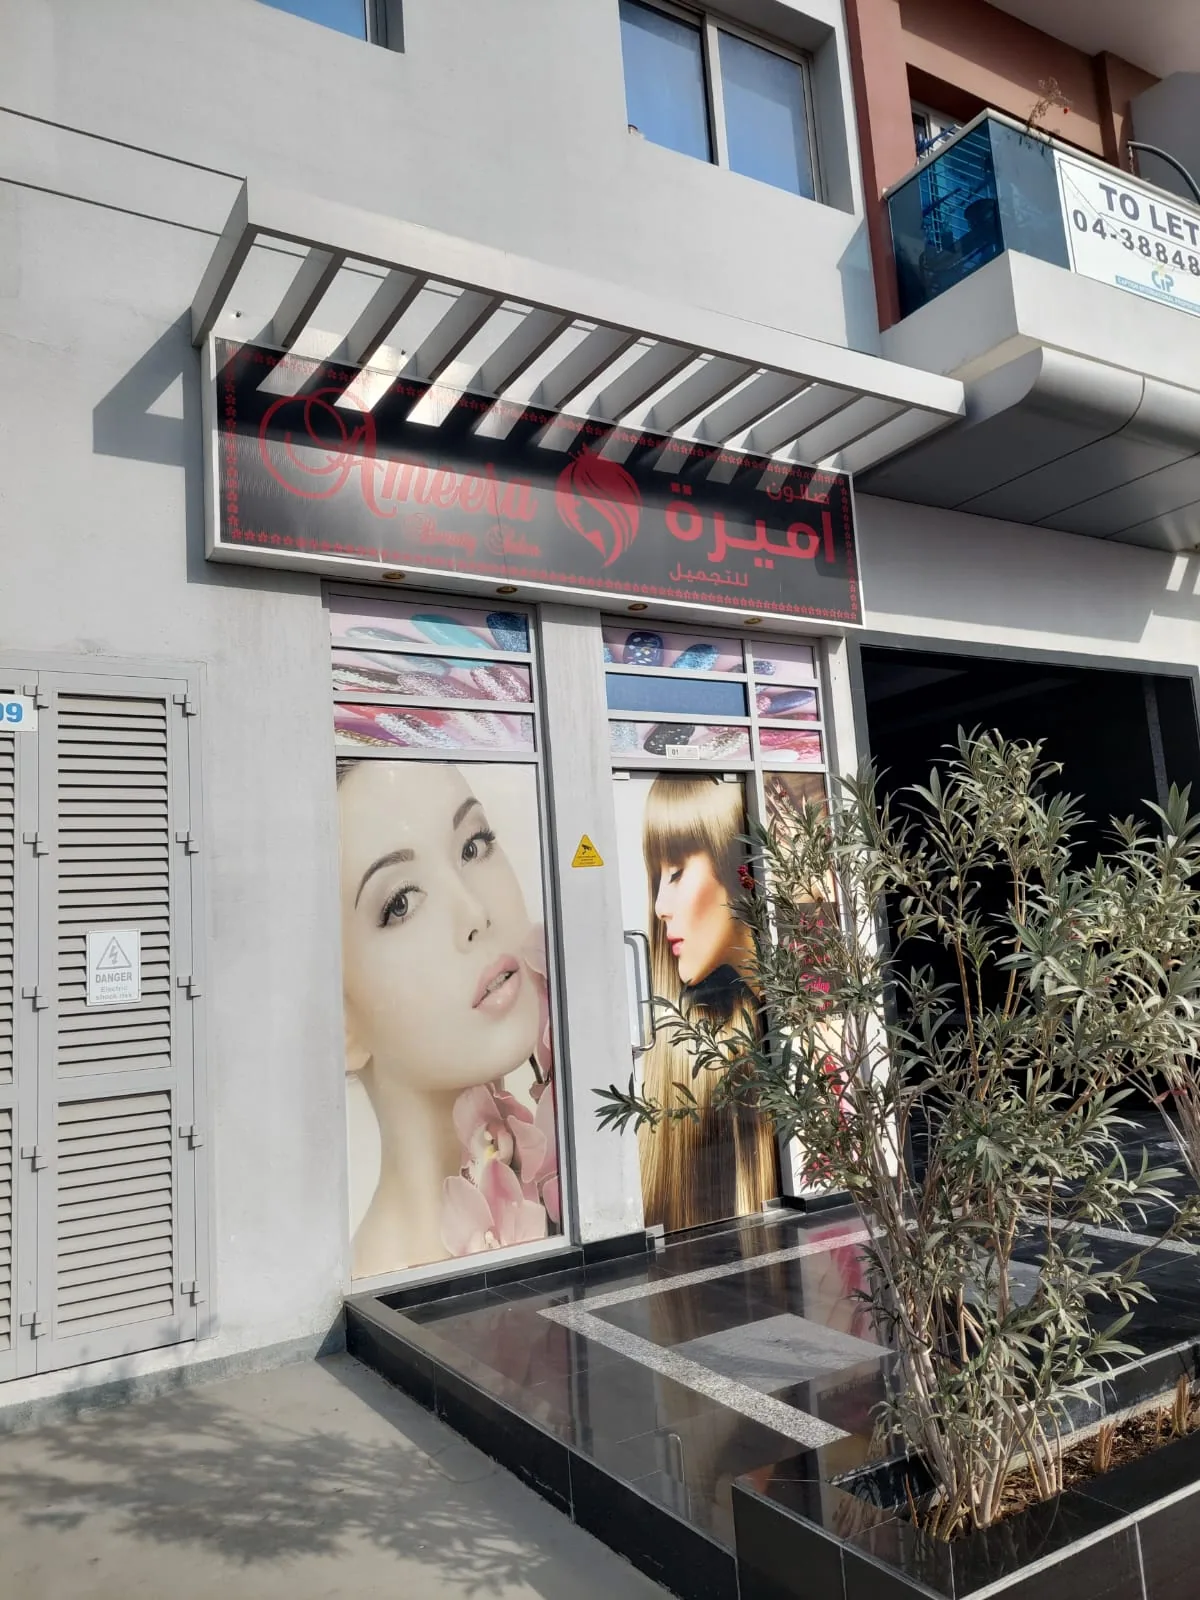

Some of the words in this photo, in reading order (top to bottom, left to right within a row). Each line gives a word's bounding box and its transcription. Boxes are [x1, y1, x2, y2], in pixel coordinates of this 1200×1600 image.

[1099, 182, 1140, 221] TO
[1150, 204, 1200, 246] LET
[1072, 209, 1200, 277] 04-38848
[259, 387, 538, 522] Ameera
[765, 481, 830, 505] صالون
[668, 560, 749, 588] للتجميل
[95, 971, 133, 983] DANGER
